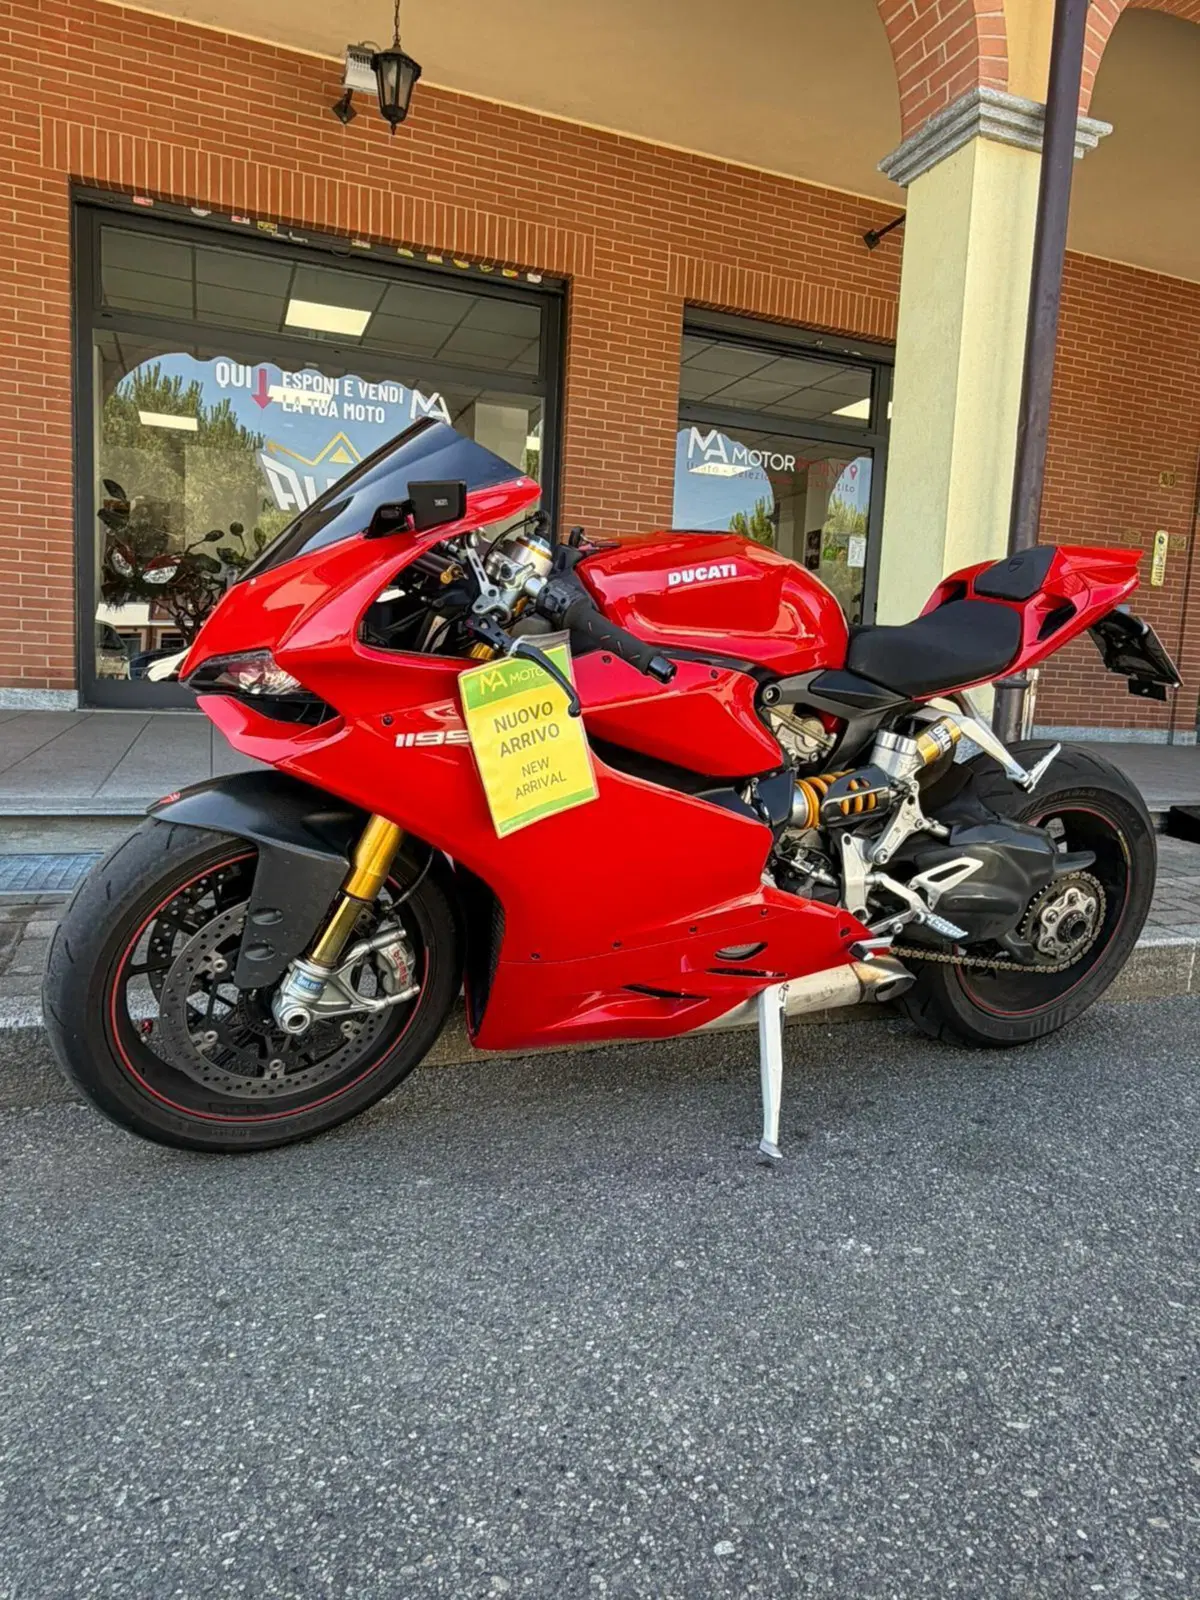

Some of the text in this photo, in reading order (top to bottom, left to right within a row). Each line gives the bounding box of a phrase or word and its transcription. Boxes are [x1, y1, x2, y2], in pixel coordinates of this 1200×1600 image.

[215, 362, 251, 389] QUI
[282, 371, 404, 405] ESPONI E VENDI
[282, 394, 385, 424] LA TUA MOTO
[687, 426, 729, 463] MA
[732, 447, 796, 473] MOTOR
[667, 564, 737, 586] DUCATI
[509, 667, 545, 686] MOTO
[493, 701, 553, 734] NUOVO
[500, 723, 560, 758] ARRIVO
[521, 756, 549, 777] NEW
[516, 770, 567, 800] ARRIVAL
